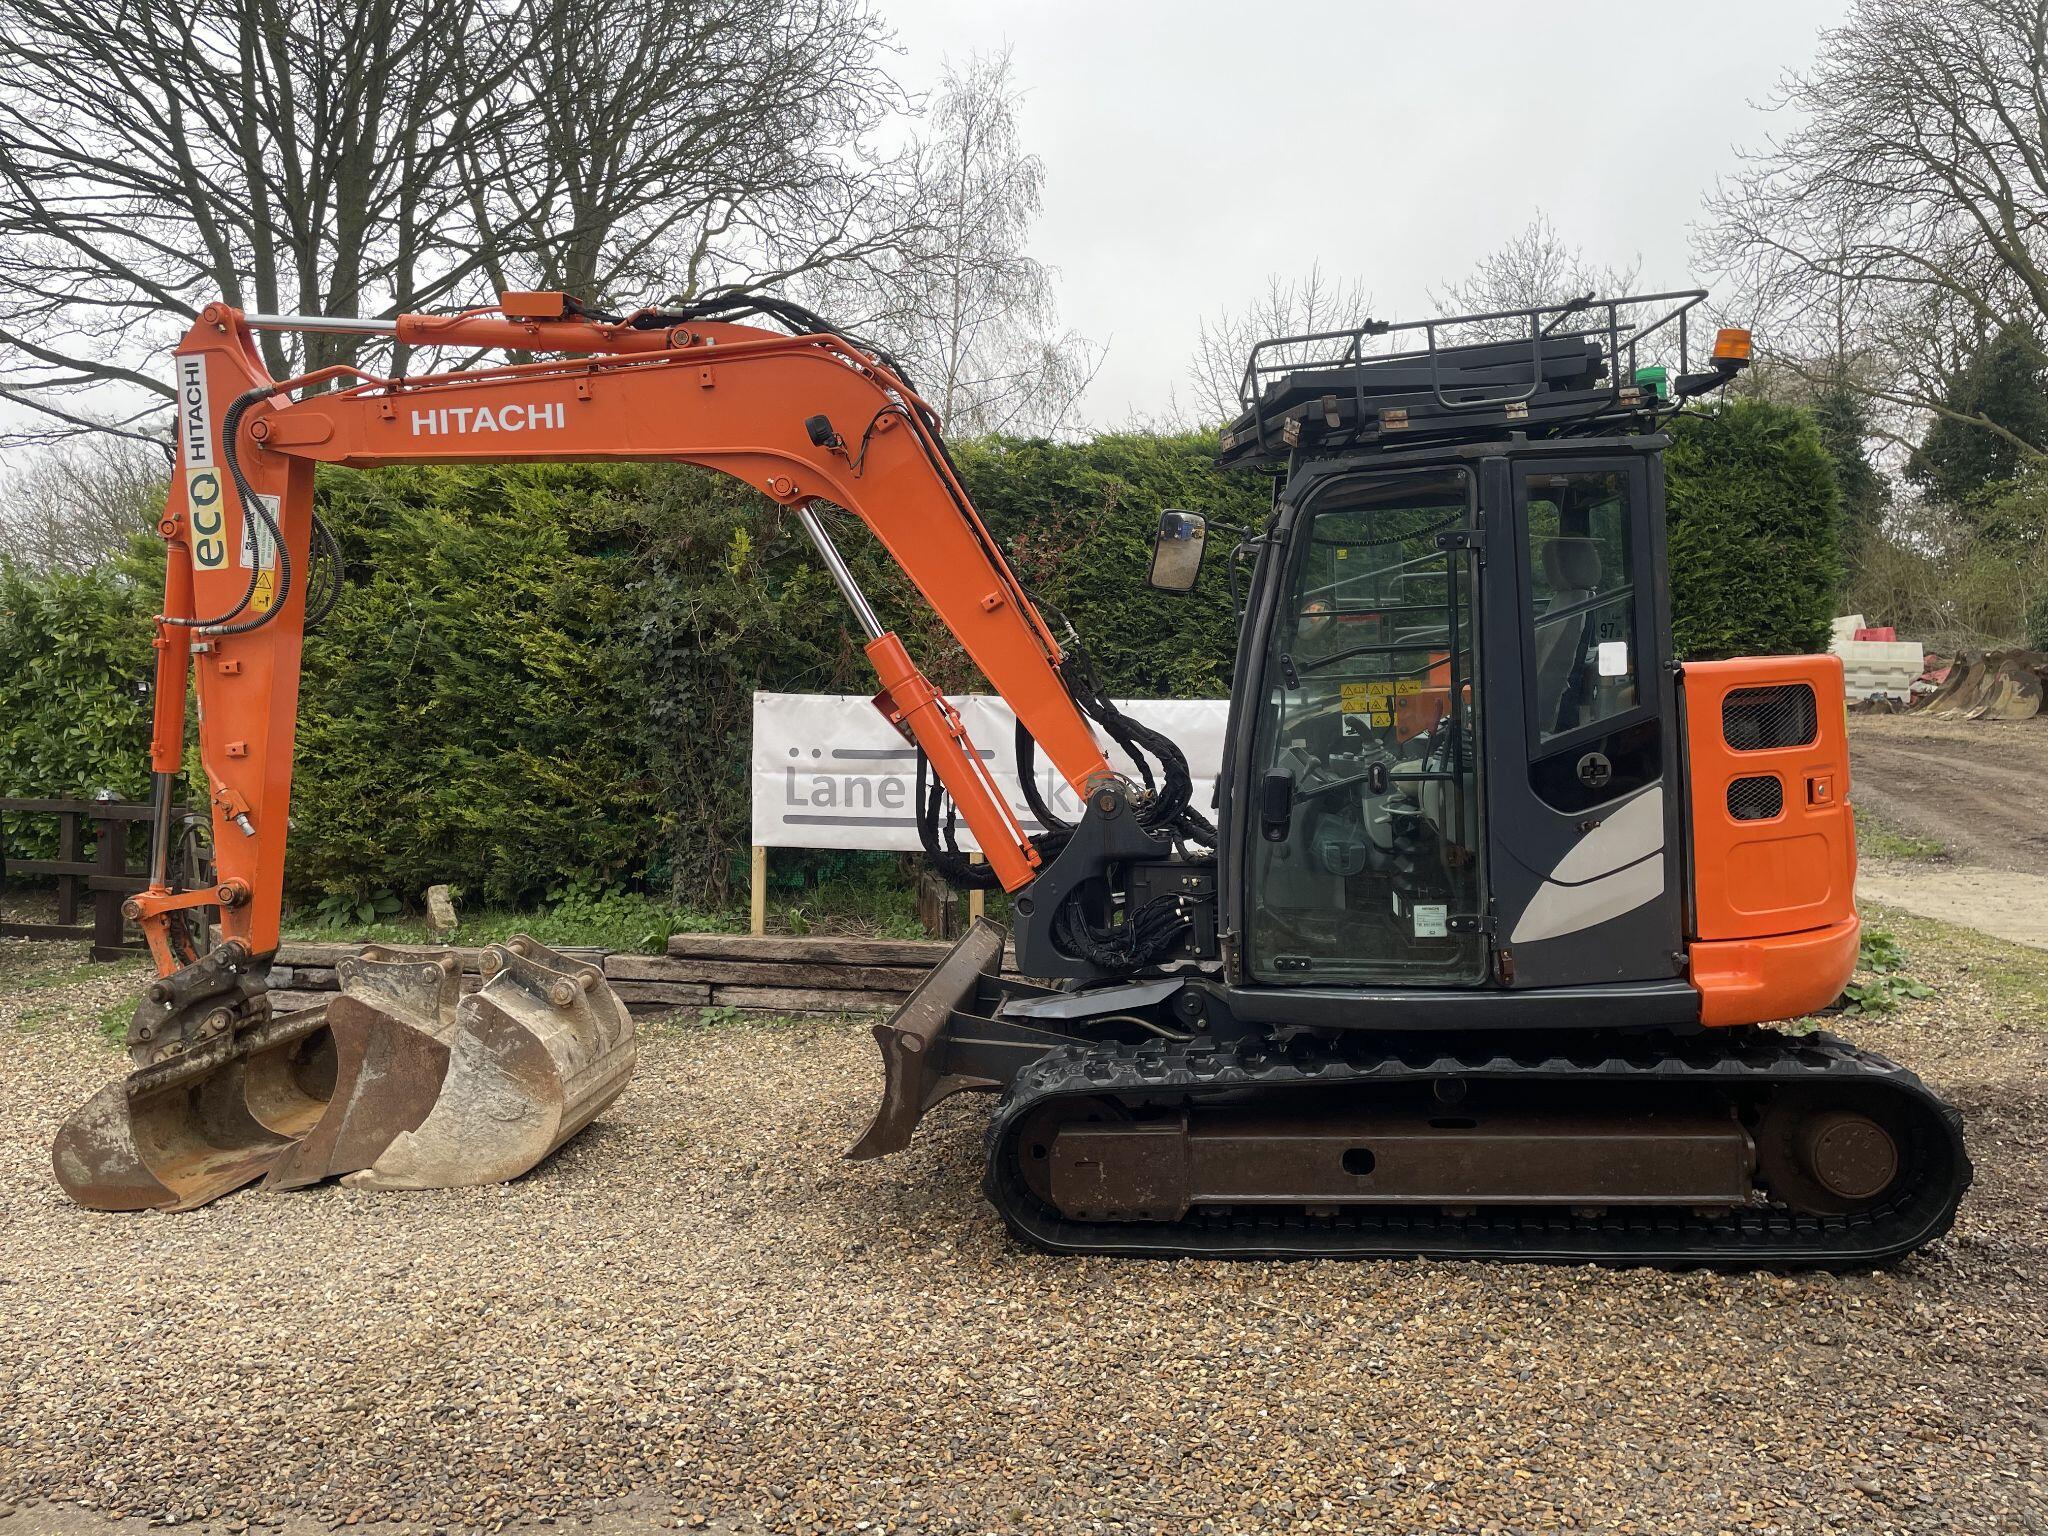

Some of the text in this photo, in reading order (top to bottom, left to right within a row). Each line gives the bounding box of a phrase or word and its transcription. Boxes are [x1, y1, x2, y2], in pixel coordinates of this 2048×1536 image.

[184, 361, 206, 462] HITACHI
[411, 402, 565, 436] HITACHI
[1600, 622, 1615, 639] 97
[786, 766, 906, 809] Lane
